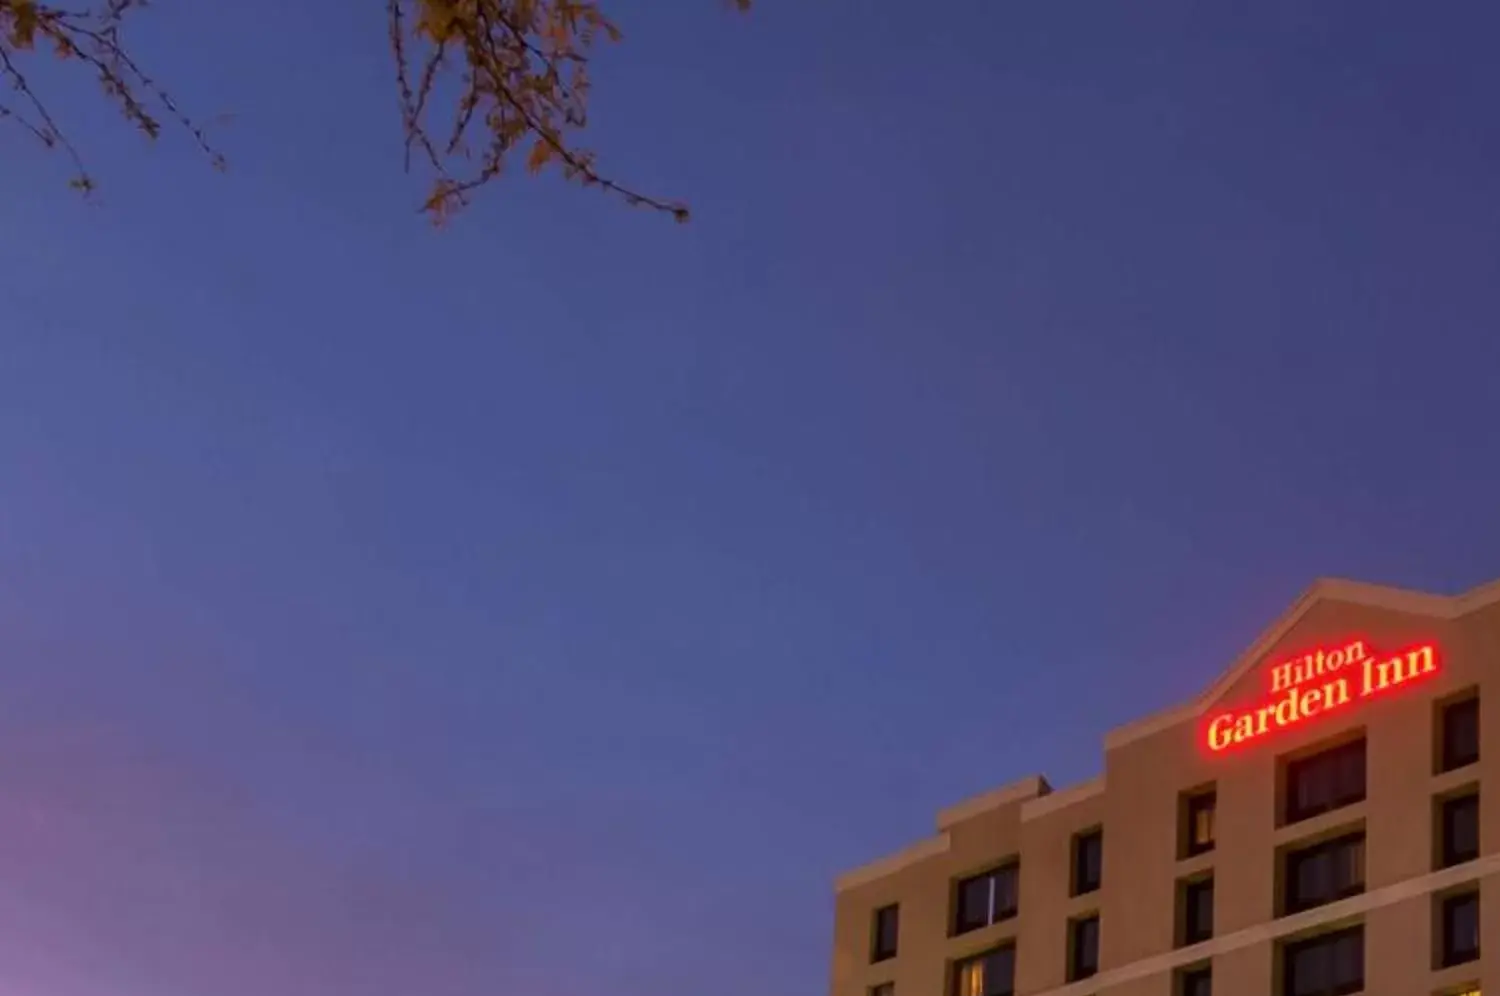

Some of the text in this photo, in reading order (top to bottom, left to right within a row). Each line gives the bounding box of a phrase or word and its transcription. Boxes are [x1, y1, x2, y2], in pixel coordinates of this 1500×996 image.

[1207, 644, 1437, 751] Garden Inn
[1270, 640, 1366, 693] Hilton
